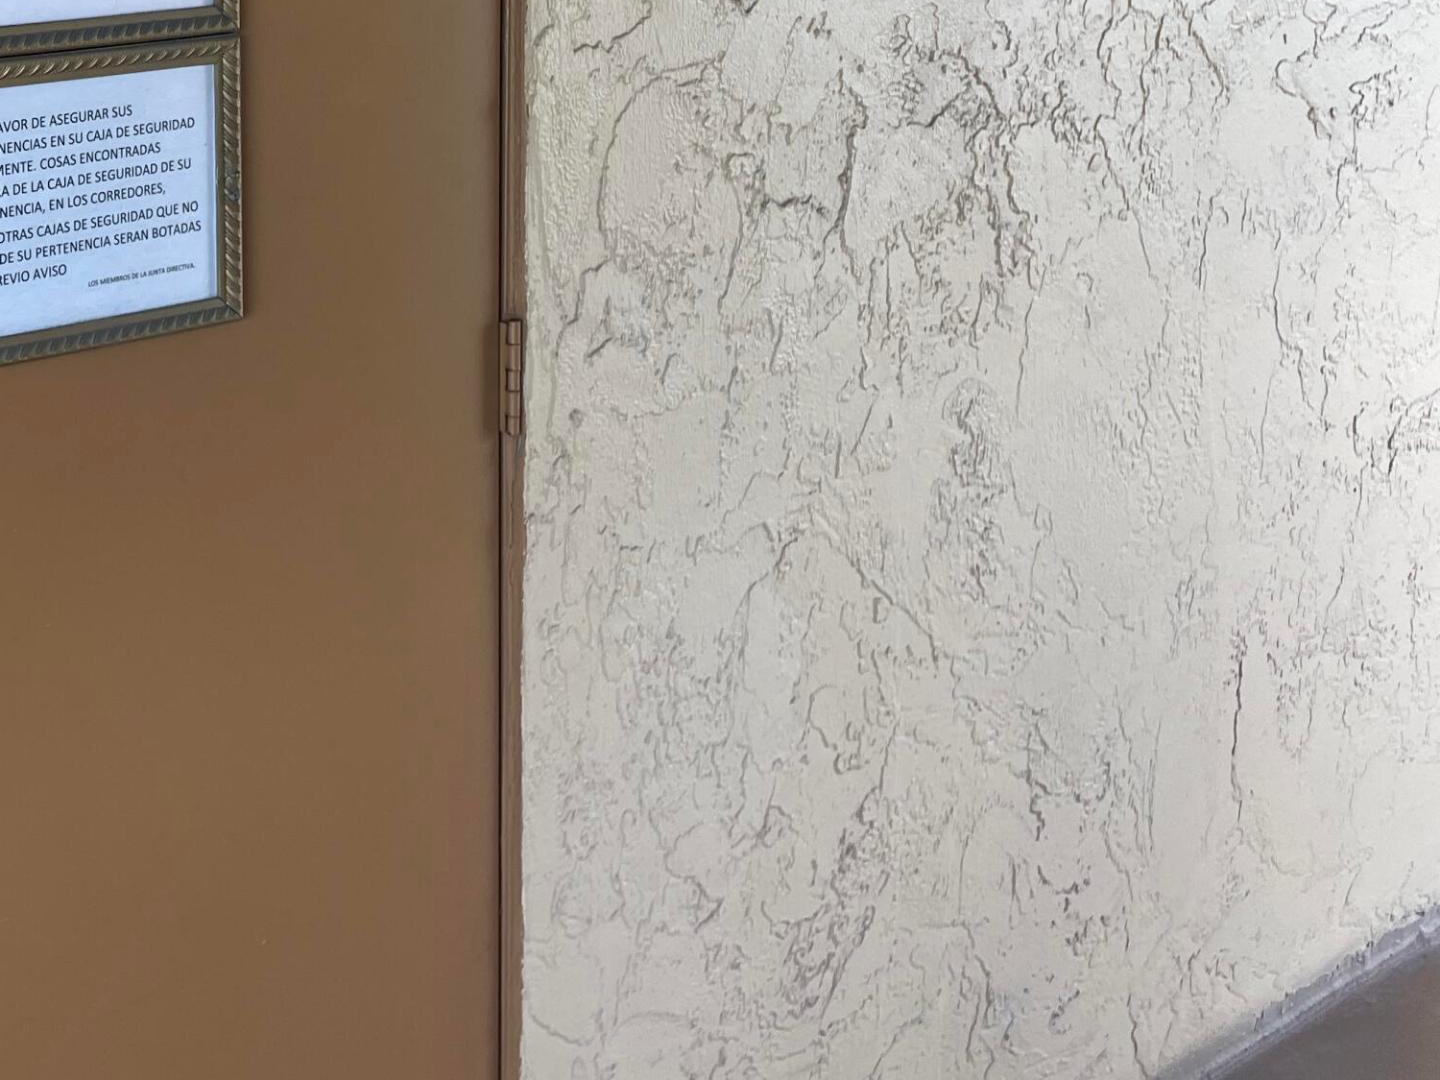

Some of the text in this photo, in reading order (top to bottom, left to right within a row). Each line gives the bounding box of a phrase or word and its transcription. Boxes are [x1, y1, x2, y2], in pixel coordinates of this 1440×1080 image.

[31, 116, 46, 128] DE
[49, 108, 109, 126] ASEGURAR
[112, 105, 133, 118] SUS
[50, 135, 65, 148] EN
[68, 132, 83, 144] SU
[86, 129, 113, 143] CAJA
[116, 127, 130, 139] DE
[133, 117, 195, 136] SEGURIDAD
[40, 153, 77, 170] COSAS
[80, 142, 161, 165] ENCONTRADAS
[13, 183, 27, 195] DE
[31, 180, 44, 192] LA
[47, 175, 75, 189] CAJA
[78, 173, 92, 185] DE
[95, 163, 158, 183] SEGURIDAD
[161, 160, 175, 172] DE
[178, 158, 192, 170] SU
[49, 199, 64, 211] EN
[67, 194, 88, 208] LOS
[90, 183, 166, 206] CORREDORES,
[37, 221, 71, 237] CAJAS
[74, 219, 88, 231] DE
[90, 208, 154, 228] SEGURIDAD
[156, 204, 179, 218] QUE
[182, 201, 199, 213] NO
[0, 251, 14, 264] DE
[17, 247, 32, 262] SU
[35, 236, 111, 258] PERTENENCIA
[114, 229, 149, 246] SERAN
[152, 221, 202, 239] BOTADAS
[33, 263, 67, 280] AVISO
